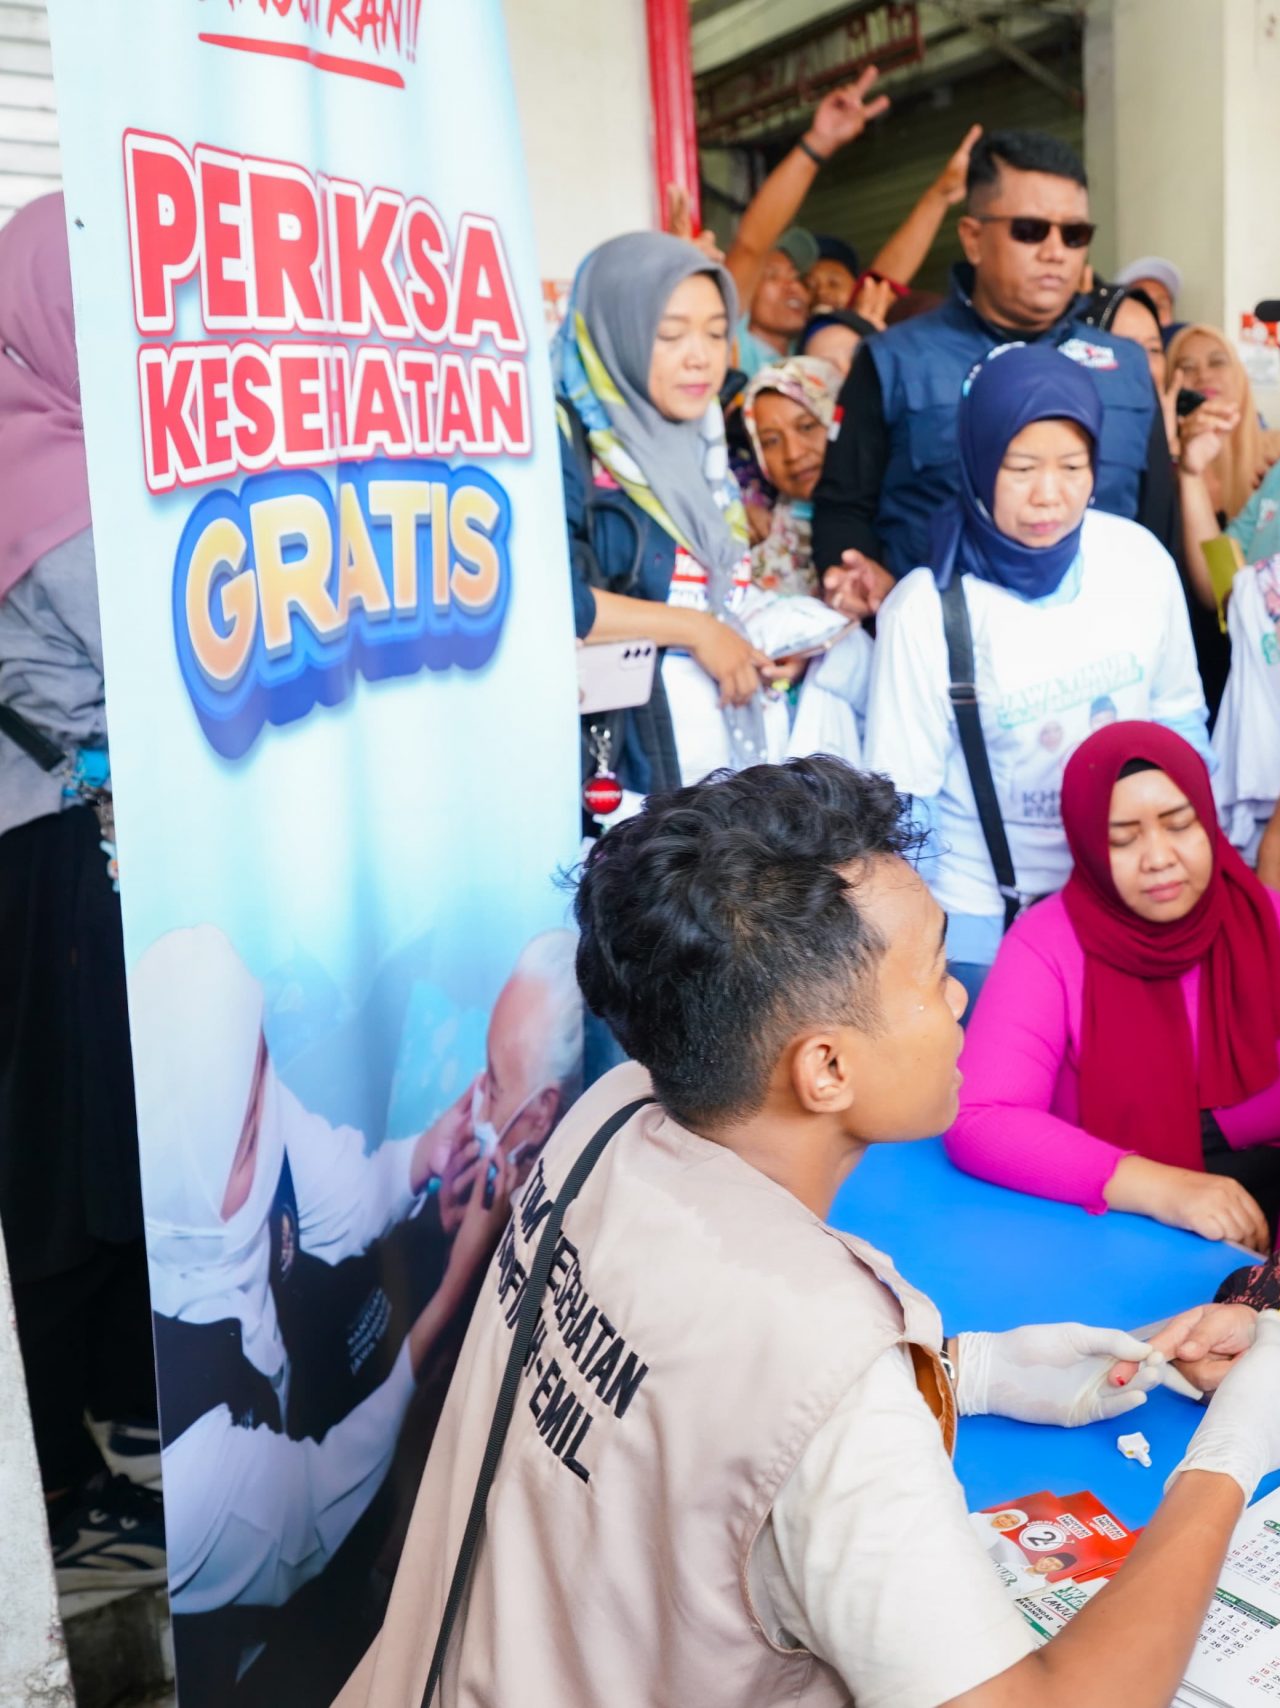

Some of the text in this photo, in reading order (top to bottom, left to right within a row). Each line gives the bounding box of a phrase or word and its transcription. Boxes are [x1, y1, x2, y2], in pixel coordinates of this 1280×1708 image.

[124, 129, 528, 352] PERIKSA
[138, 343, 533, 496] KESEHATAN
[183, 477, 504, 689] GRATIS
[548, 1228, 649, 1419] ESEHATAN
[1027, 1531, 1057, 1547] 2
